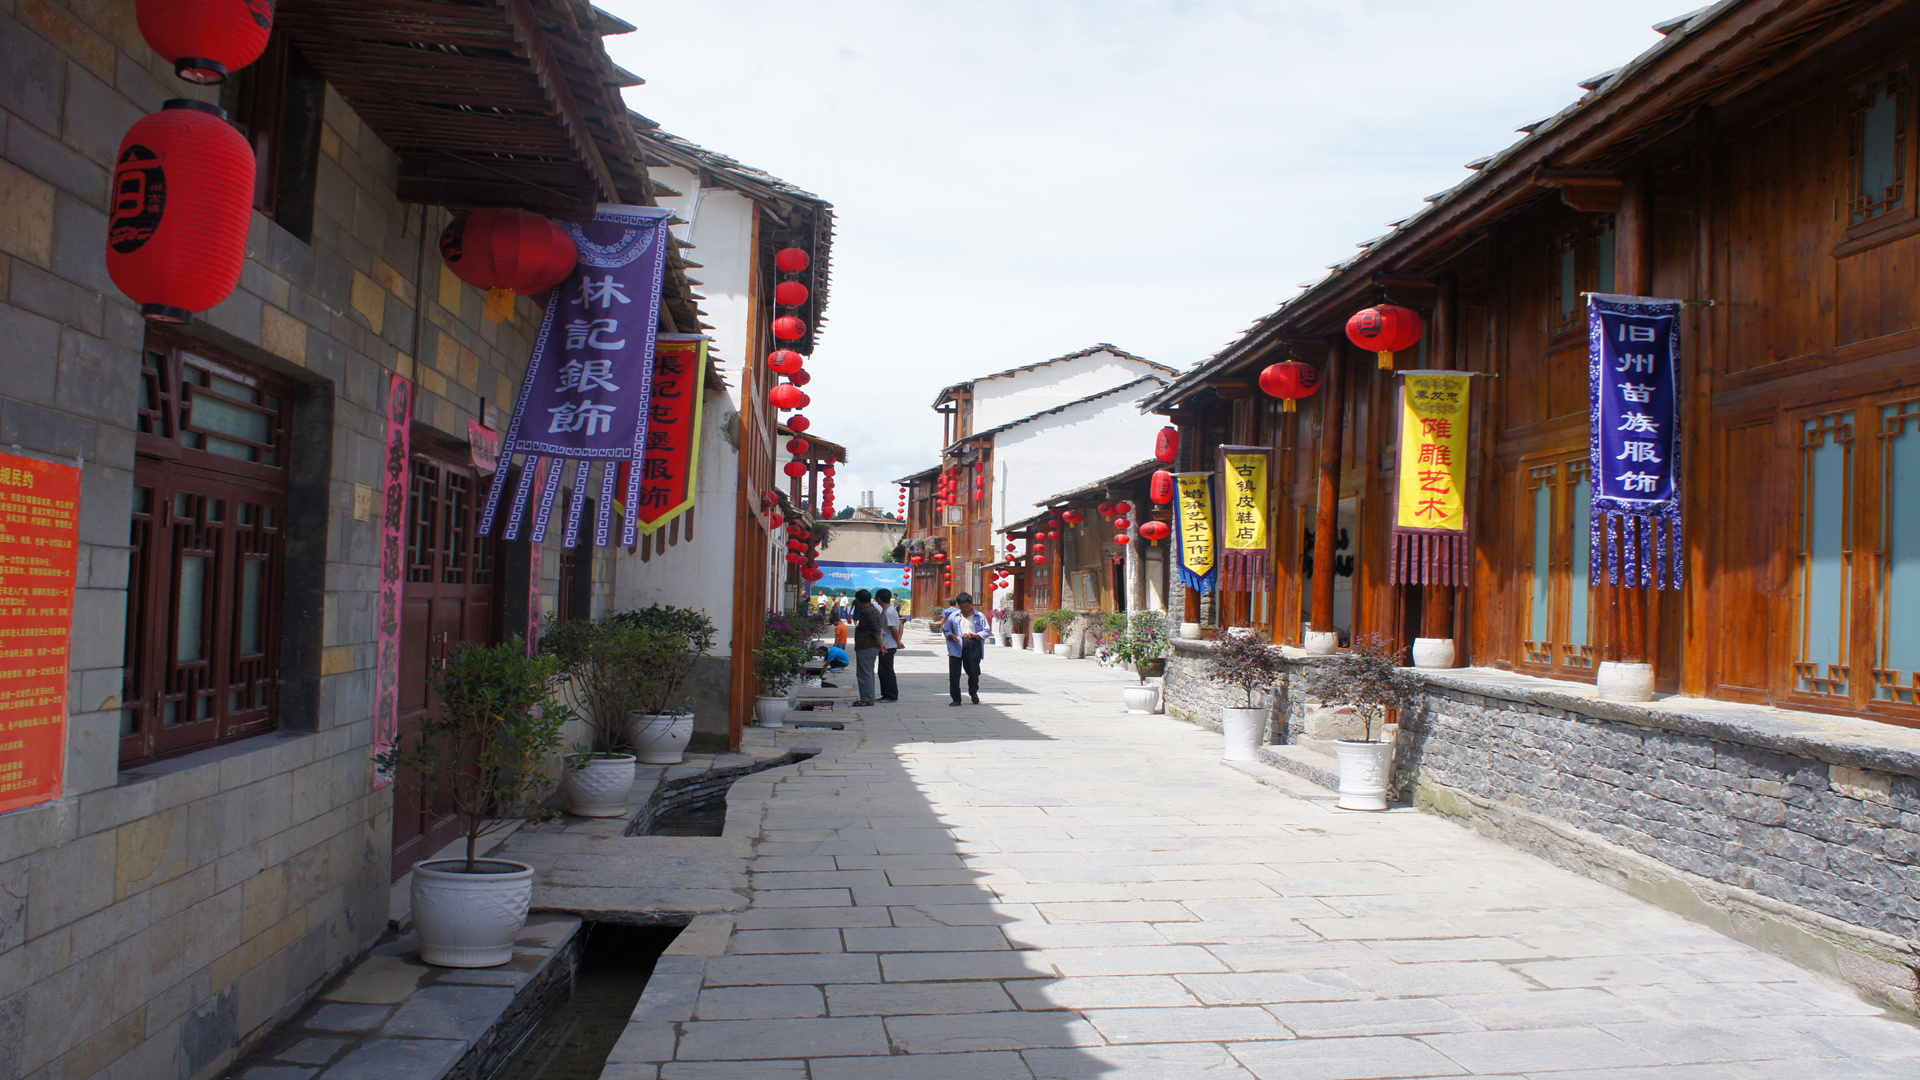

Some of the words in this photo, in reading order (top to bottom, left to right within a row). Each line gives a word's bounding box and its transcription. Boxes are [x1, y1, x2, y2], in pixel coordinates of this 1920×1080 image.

[548, 275, 632, 436] 林記銀飾
[1615, 323, 1662, 493] 旧州苗族服饰
[1235, 464, 1257, 540] 古镇皮鞋店
[1414, 416, 1453, 521] 傩雕艺术
[1183, 488, 1210, 566] 蜡染艺术工作室
